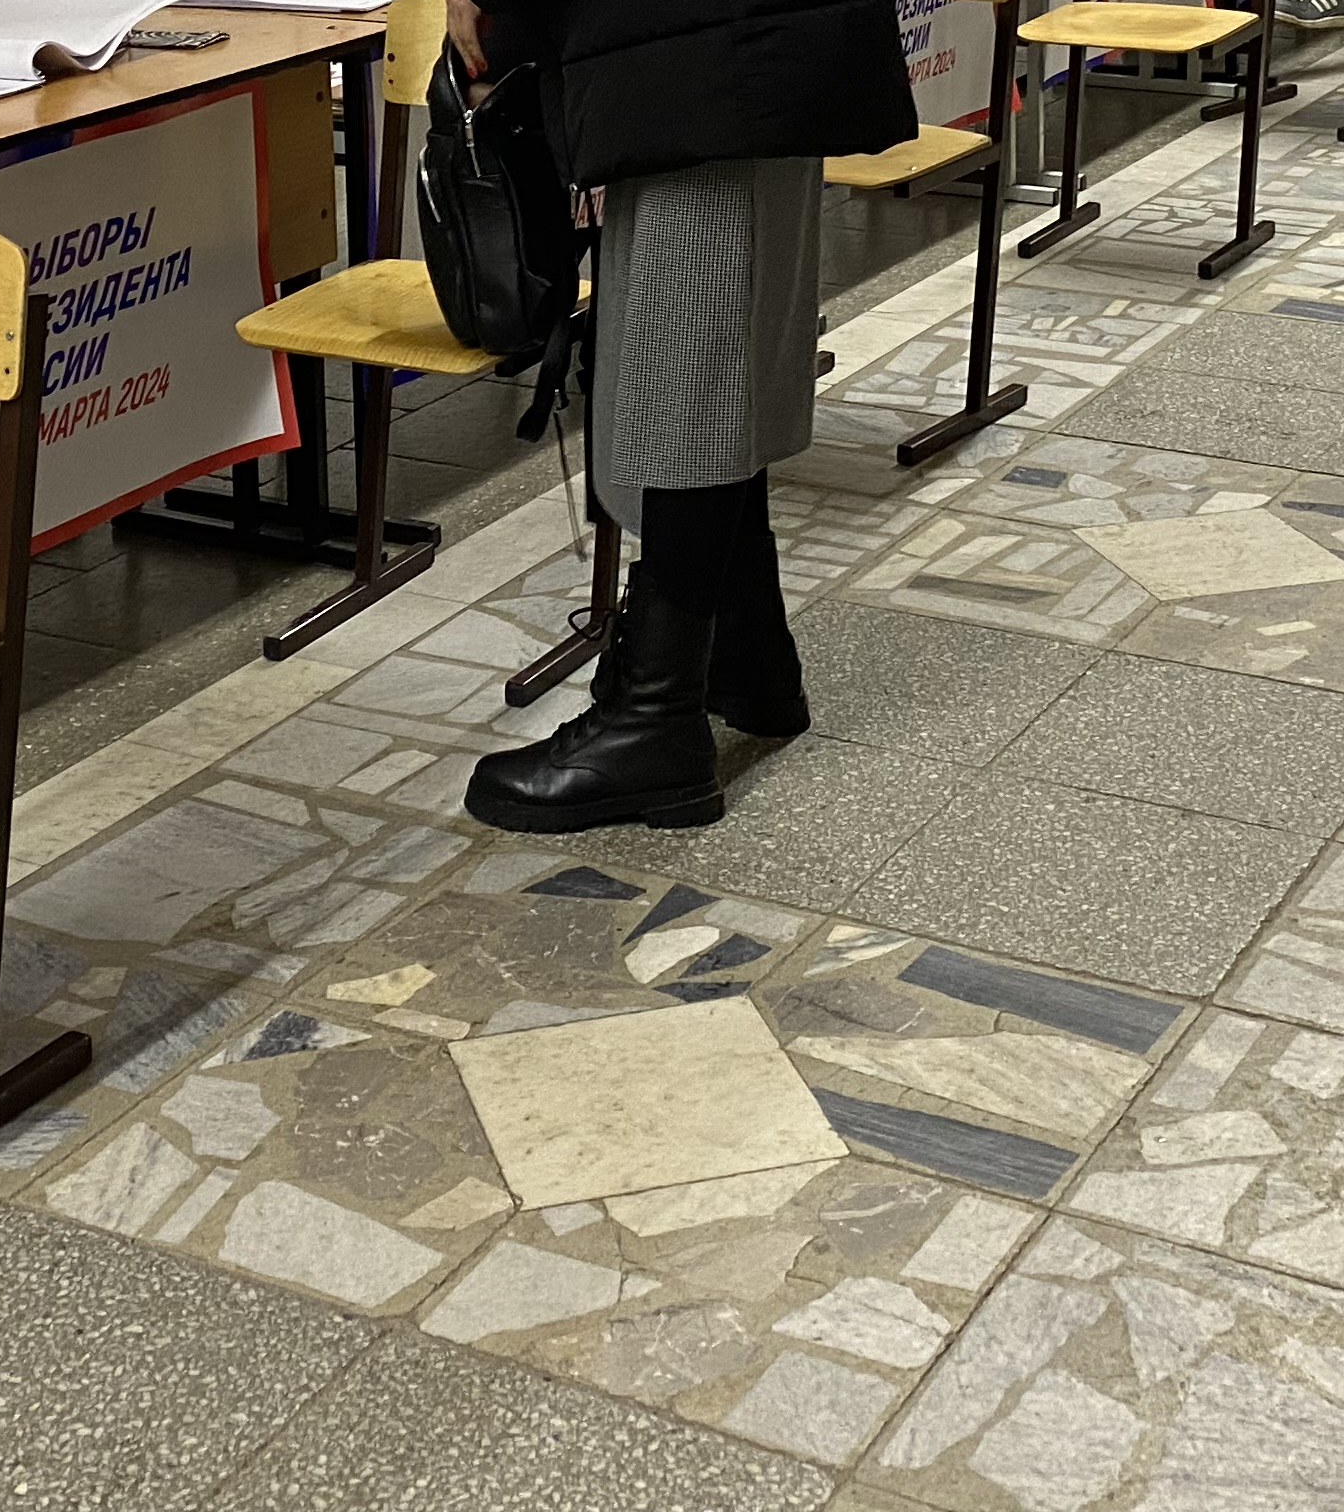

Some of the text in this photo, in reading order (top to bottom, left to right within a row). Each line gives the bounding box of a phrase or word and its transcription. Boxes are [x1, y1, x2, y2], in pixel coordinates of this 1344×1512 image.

[900, 21, 932, 57] СИИ
[908, 47, 956, 85] АРТА 2024
[24, 206, 156, 285] ЫБОРЫ
[46, 246, 192, 335] ЗИДЕНТА
[39, 386, 112, 446] МАРТА
[115, 363, 171, 418] 2024
